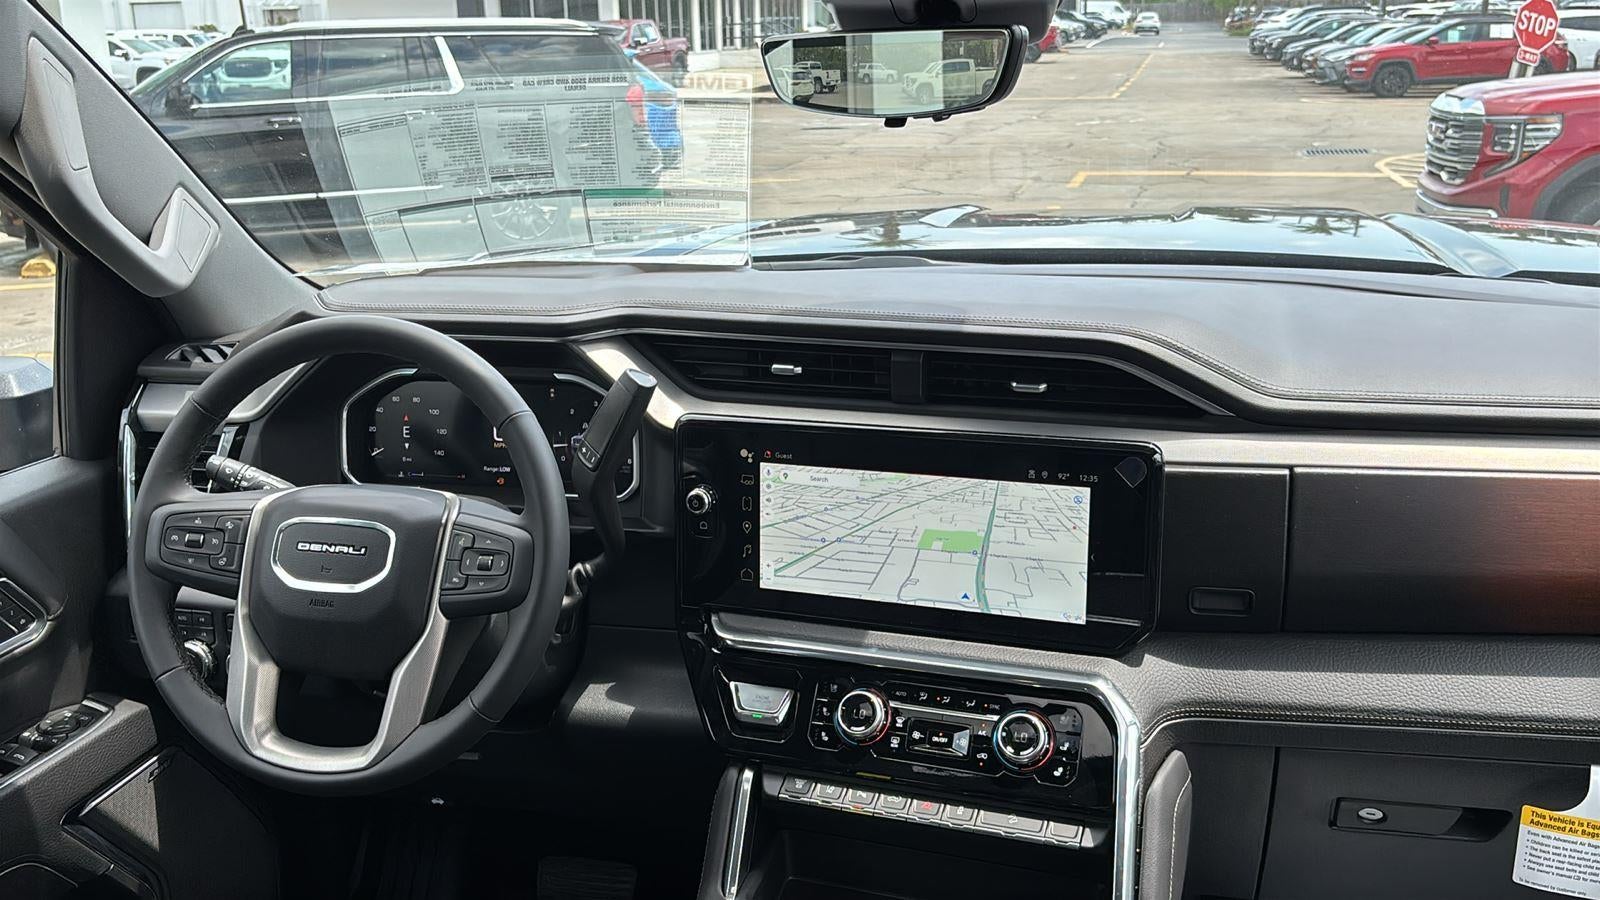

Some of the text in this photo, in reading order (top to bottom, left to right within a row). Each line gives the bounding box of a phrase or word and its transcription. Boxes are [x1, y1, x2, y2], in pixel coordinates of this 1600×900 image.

[1518, 10, 1556, 37] STOP
[402, 426, 411, 438] E
[775, 452, 792, 460] Guest
[1079, 474, 1099, 483] 12:35
[298, 542, 366, 554] DENALI
[309, 598, 334, 608] AIRBAG
[853, 709, 866, 720] LO
[1014, 731, 1028, 742] LO
[1531, 810, 1547, 820] This
[1549, 814, 1575, 826] Vehicle
[1587, 821, 1600, 832] Equ
[1530, 818, 1566, 832] Advanced
[1581, 828, 1600, 839] Bags
[1527, 830, 1540, 838] Even
[1553, 836, 1578, 846] Advanced
[1530, 839, 1551, 848] Children
[1569, 846, 1583, 854] killed
[1527, 859, 1544, 868] Always
[1528, 852, 1542, 860] Never
[1555, 858, 1582, 868] rear-facing
[1536, 868, 1555, 876] owner's
[1531, 881, 1549, 889] removed
[1556, 886, 1576, 894] customer
